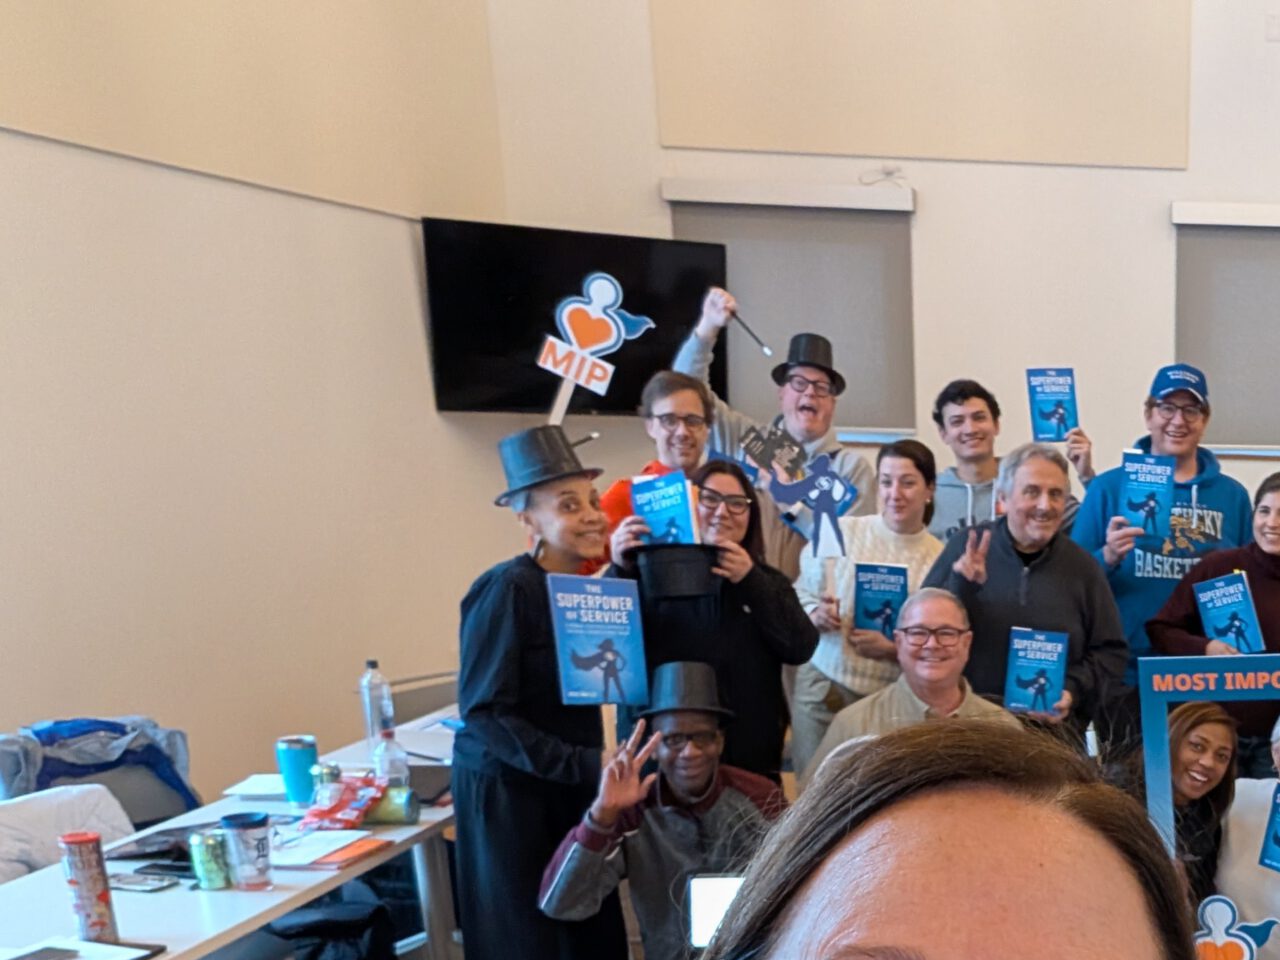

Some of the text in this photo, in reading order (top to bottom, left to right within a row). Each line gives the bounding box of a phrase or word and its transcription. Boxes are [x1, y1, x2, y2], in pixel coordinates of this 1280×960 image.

[541, 340, 609, 385] MIP
[1125, 462, 1171, 476] SUPERPOWER
[1137, 472, 1167, 484] SERVICE
[1198, 583, 1244, 603] SUPERPOWER
[1214, 592, 1243, 607] SERVICE
[556, 593, 634, 611] SUPERPOWER
[579, 610, 629, 624] SERVICE
[1013, 639, 1063, 653] SUPERPOWER
[1026, 649, 1058, 661] SERVICE
[1152, 673, 1219, 692] MOST
